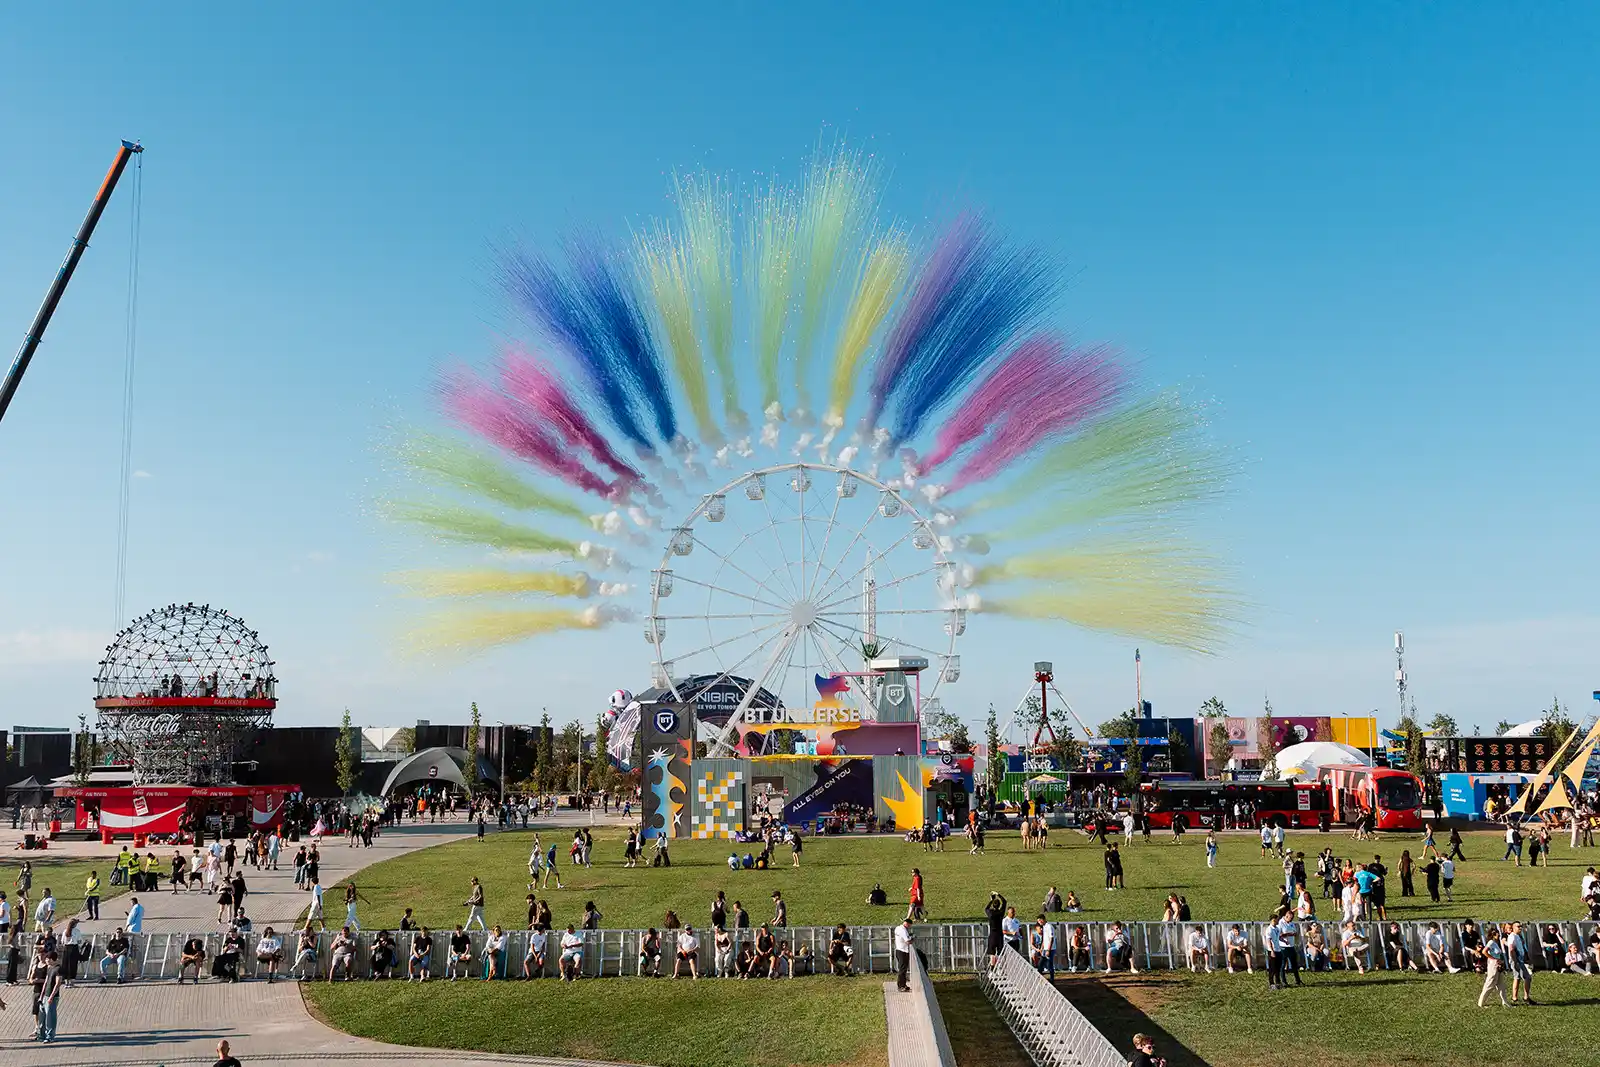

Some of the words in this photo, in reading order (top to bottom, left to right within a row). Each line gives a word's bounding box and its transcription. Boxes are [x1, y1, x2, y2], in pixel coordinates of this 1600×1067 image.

[744, 707, 768, 723] BT
[792, 801, 806, 813] ALL
[805, 785, 825, 802] EYES
[824, 778, 836, 789] ON
[835, 767, 851, 780] YOU
[1049, 784, 1068, 792] FRES
